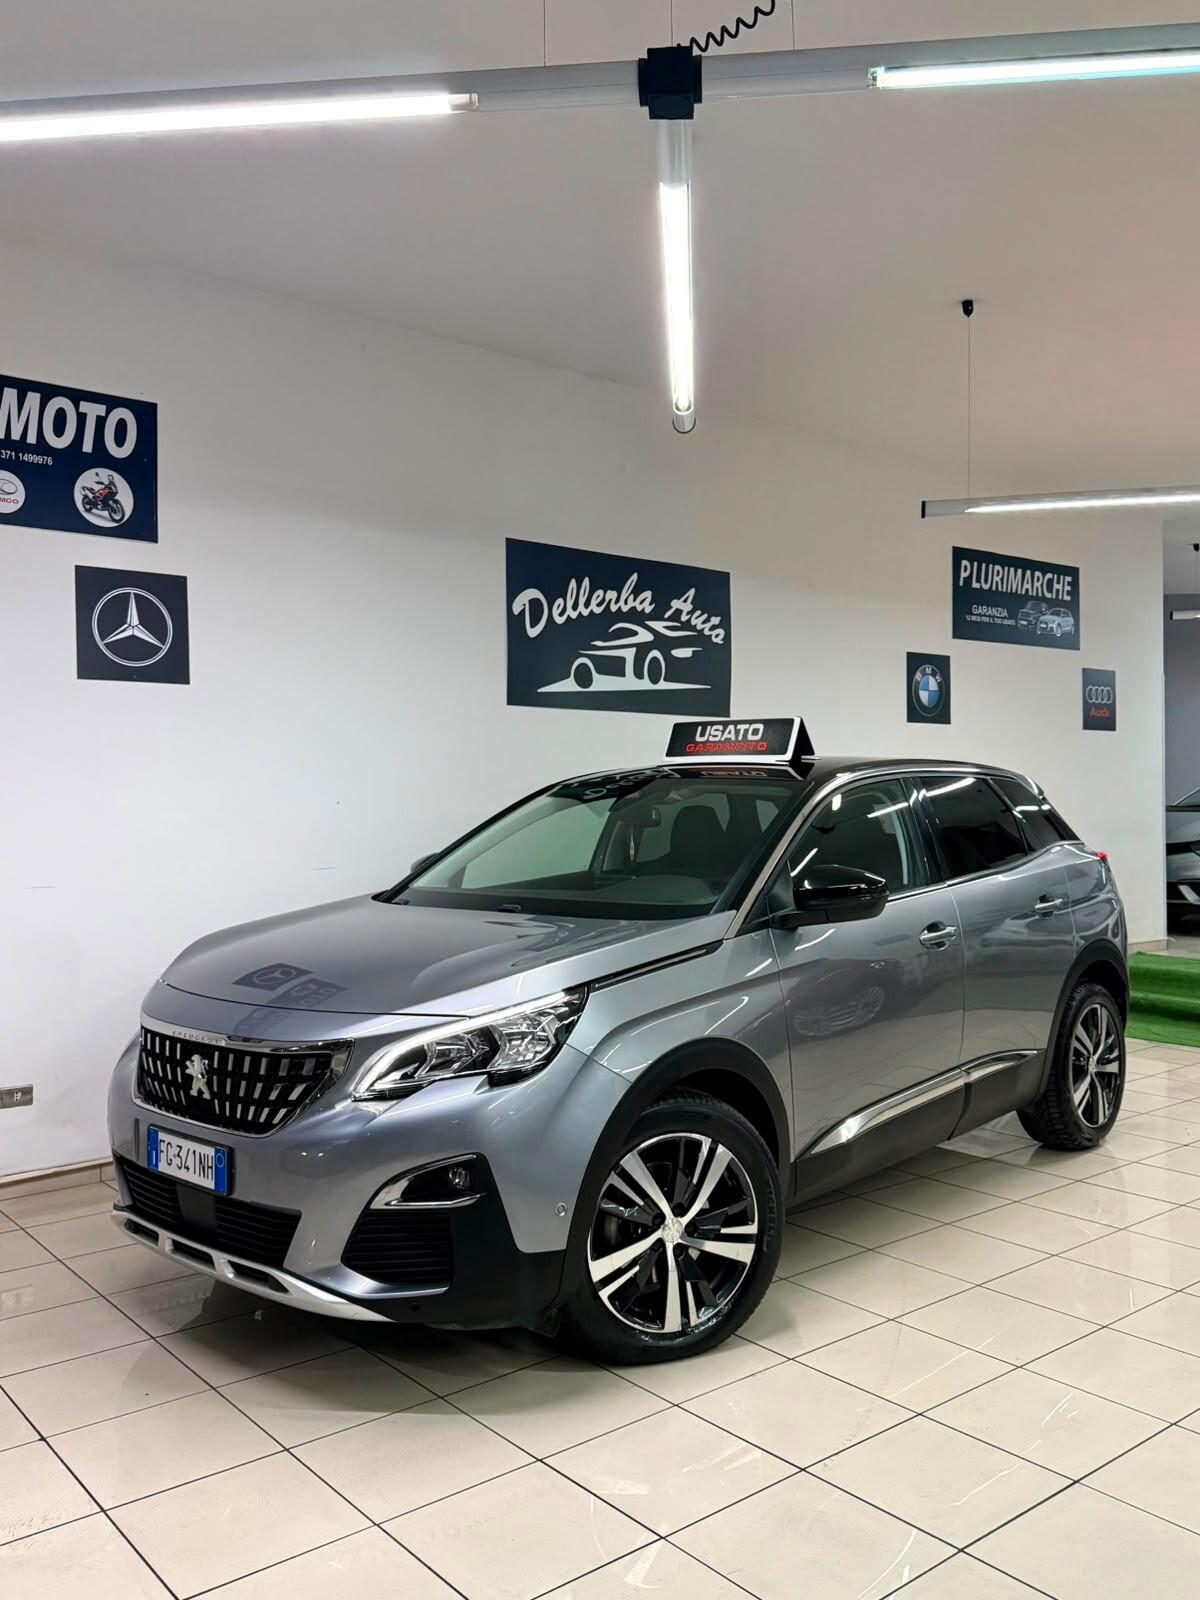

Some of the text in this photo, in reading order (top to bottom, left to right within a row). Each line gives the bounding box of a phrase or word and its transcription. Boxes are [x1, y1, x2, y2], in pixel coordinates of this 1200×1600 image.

[0, 387, 138, 459] MOTO
[0, 449, 53, 466] 371 1499976
[959, 559, 1073, 601] PLURIMARCHE
[511, 572, 726, 645] Dellerba Auto
[971, 604, 1008, 618] GARANZIA
[695, 723, 764, 742] USATO
[685, 741, 768, 753] GARANTITO
